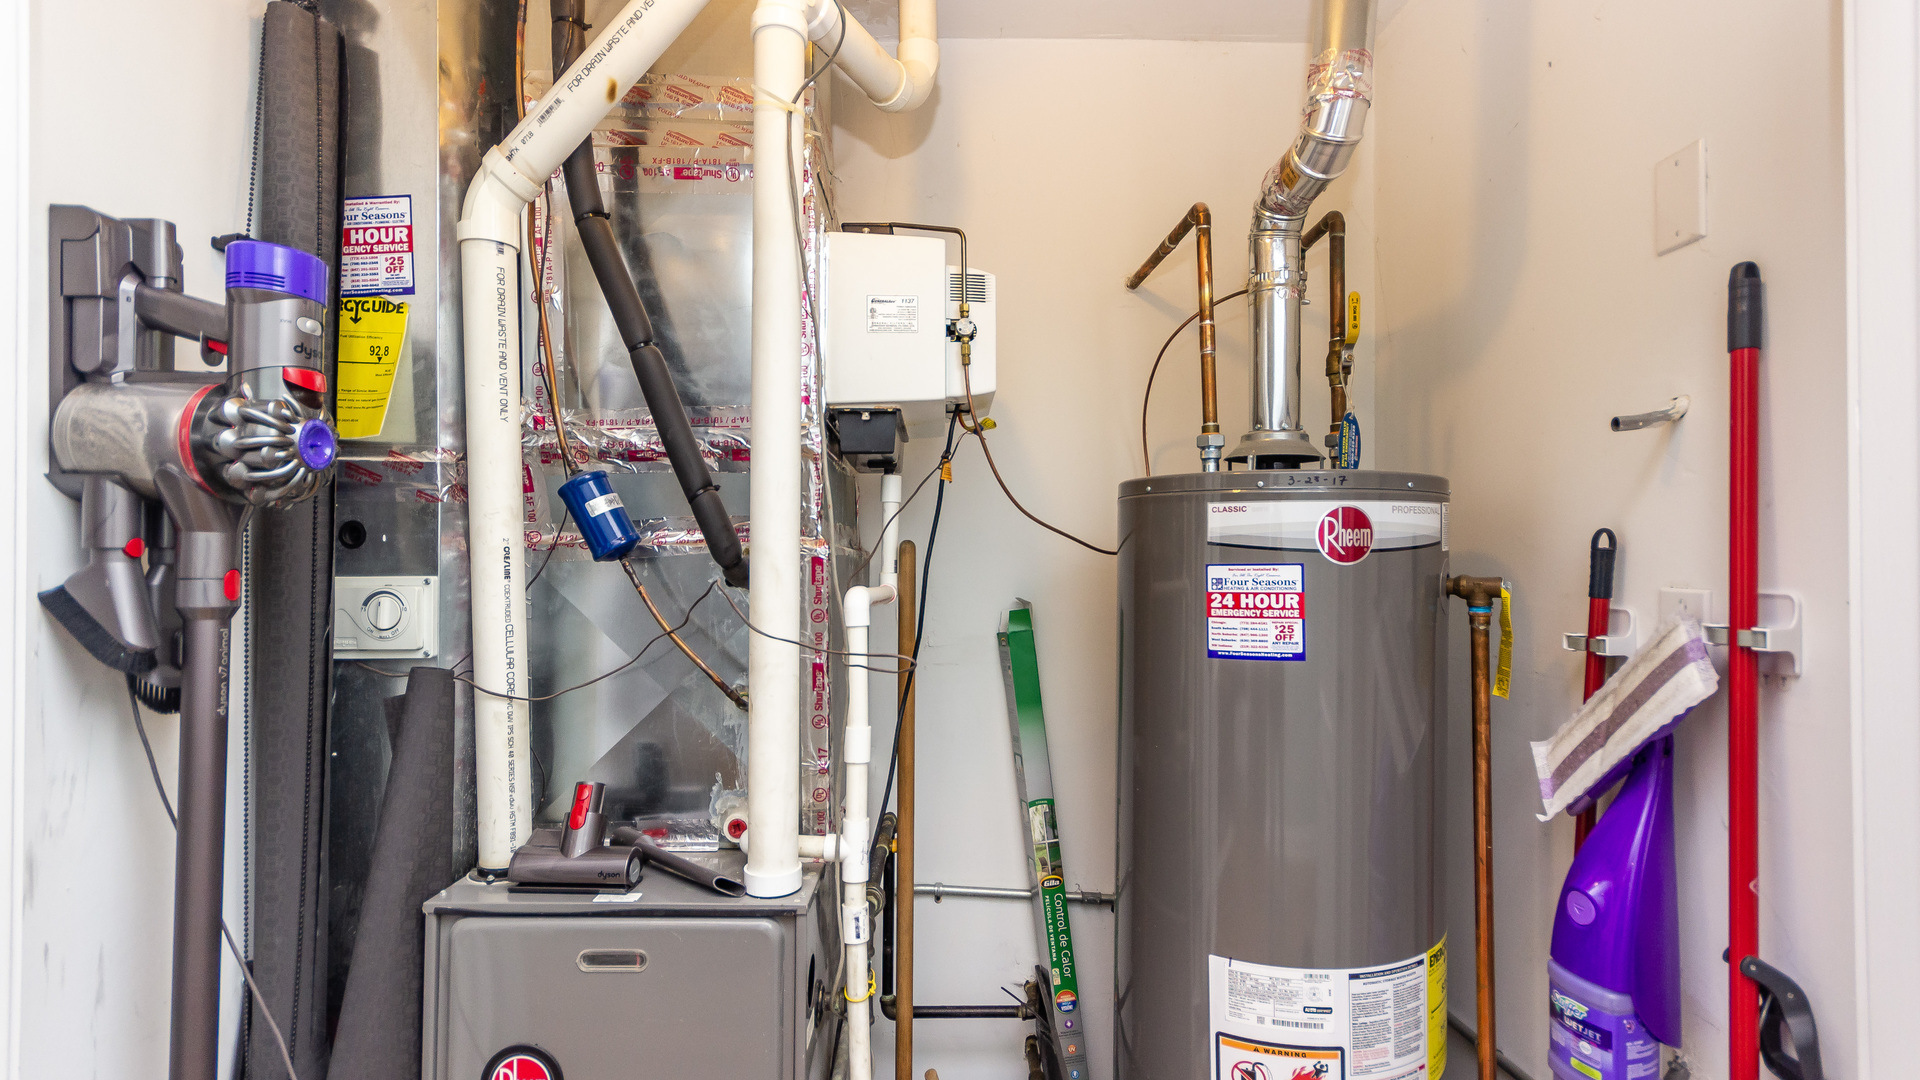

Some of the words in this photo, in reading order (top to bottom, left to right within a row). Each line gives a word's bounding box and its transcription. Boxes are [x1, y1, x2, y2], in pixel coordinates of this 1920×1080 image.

[567, 73, 585, 93] FOR
[581, 50, 606, 77] DRAIN
[603, 27, 629, 53] WASTE
[626, 9, 643, 30] AND
[640, 0, 655, 12] VE
[652, 157, 685, 165] 181B-FX
[680, 167, 722, 179] Shurtape
[344, 213, 358, 221] ur
[361, 212, 405, 220] Seasons
[350, 227, 409, 244] HOUR
[343, 245, 371, 254] GENCY
[373, 243, 409, 252] SERVICE
[385, 266, 404, 274] OFF
[496, 266, 505, 288] FOR
[340, 299, 404, 316] GYGUIDE
[497, 288, 506, 317] DRAIN
[498, 318, 507, 349] WASTE
[369, 346, 390, 356] 92.8
[498, 349, 508, 370] AND
[499, 371, 508, 397] VENT
[536, 386, 544, 401] 100
[500, 398, 509, 423] ONLY
[525, 495, 534, 506] AF
[526, 509, 536, 523] 100
[1392, 505, 1440, 515] PROFESSIONAL
[1324, 507, 1371, 555] Rheem
[812, 561, 824, 605] Shurtape
[1224, 578, 1249, 586] Four
[1252, 578, 1297, 586] Seasons
[504, 584, 512, 623] COEXTRUDED
[1210, 593, 1235, 608] 24
[1240, 594, 1300, 609] HOUR
[1211, 608, 1261, 617] EMERGENCY
[1262, 609, 1300, 618] SERVICE
[1275, 625, 1294, 634] $25
[220, 628, 229, 665] animal
[505, 624, 514, 670] CELLULAR
[815, 631, 823, 648] 100
[218, 666, 227, 679] v7
[506, 671, 516, 696] CORE
[814, 668, 824, 711] Shurtape
[217, 681, 227, 716] dyson
[817, 811, 825, 826] 100
[597, 871, 620, 880] dyson
[1043, 878, 1061, 888] Gila
[1054, 893, 1067, 932] Control
[1048, 925, 1054, 933] DE
[1049, 934, 1057, 962] VENTANA
[1059, 934, 1069, 947] de
[1061, 950, 1072, 978] Calor
[1263, 1048, 1307, 1058] WARNING
